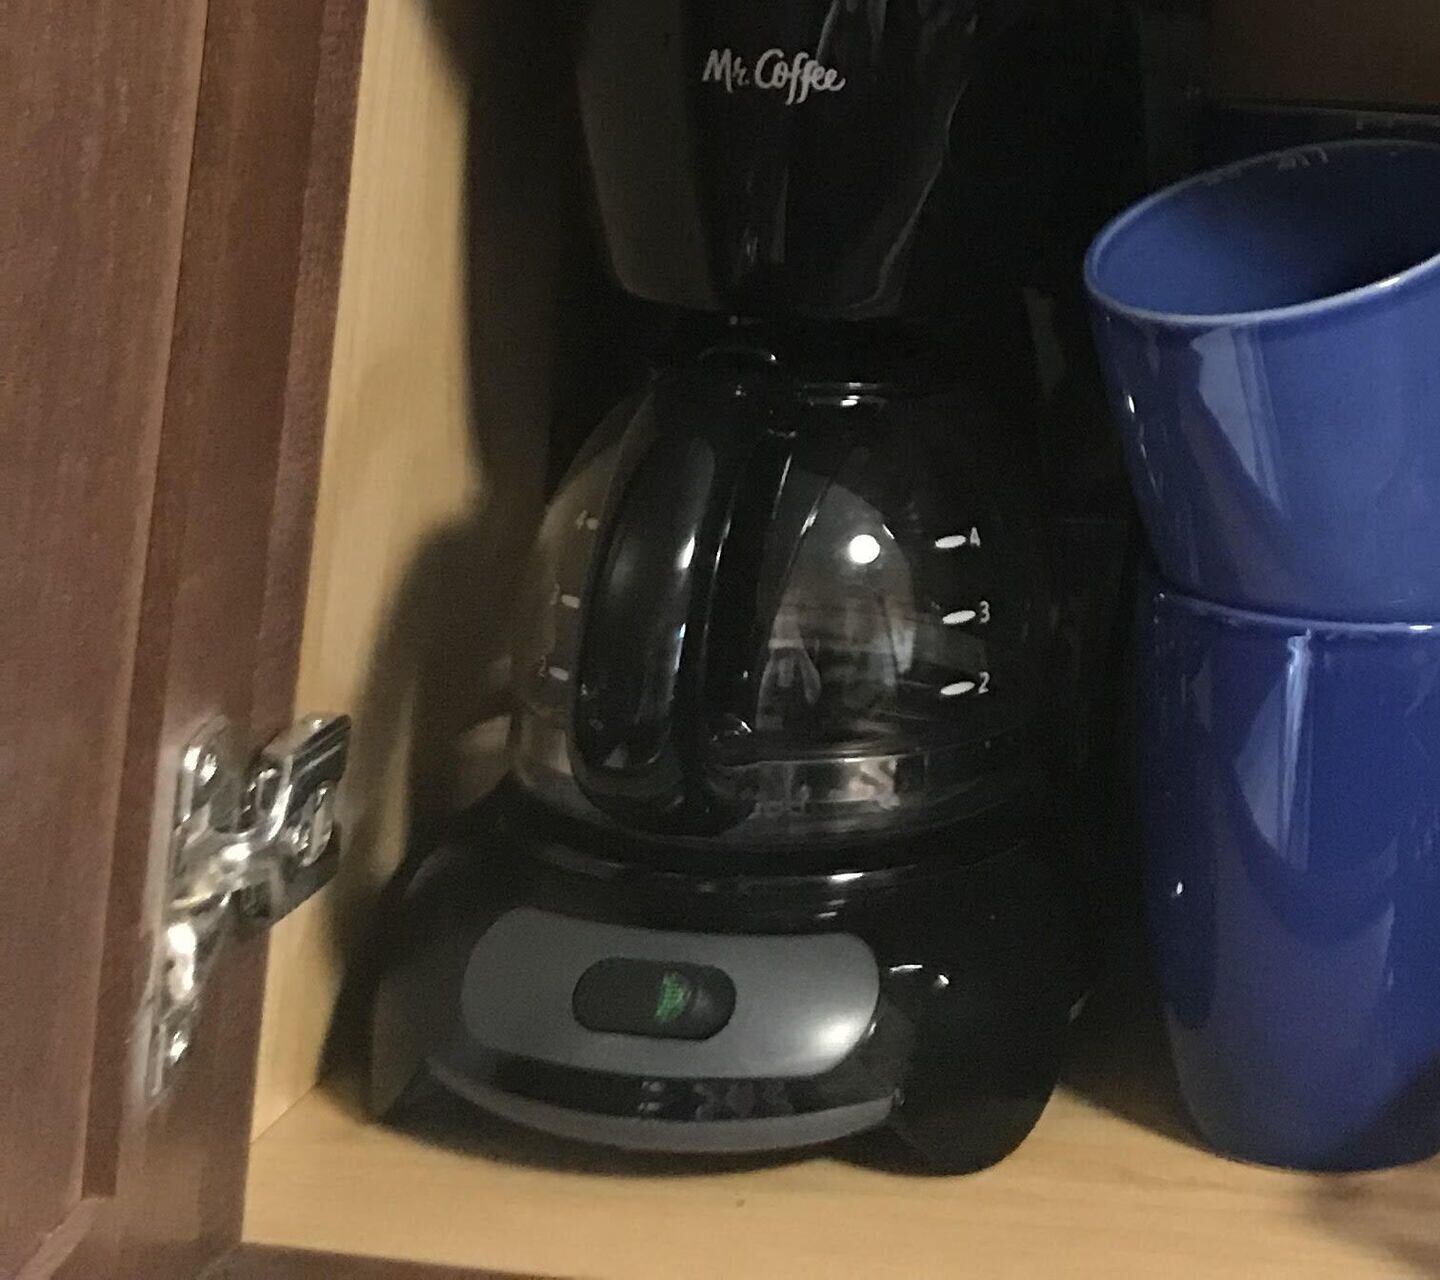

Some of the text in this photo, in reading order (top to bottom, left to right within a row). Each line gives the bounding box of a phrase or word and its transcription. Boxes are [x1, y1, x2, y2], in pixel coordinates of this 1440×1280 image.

[754, 47, 847, 106] Coffee
[979, 600, 991, 624] 3
[978, 671, 990, 694] 2
